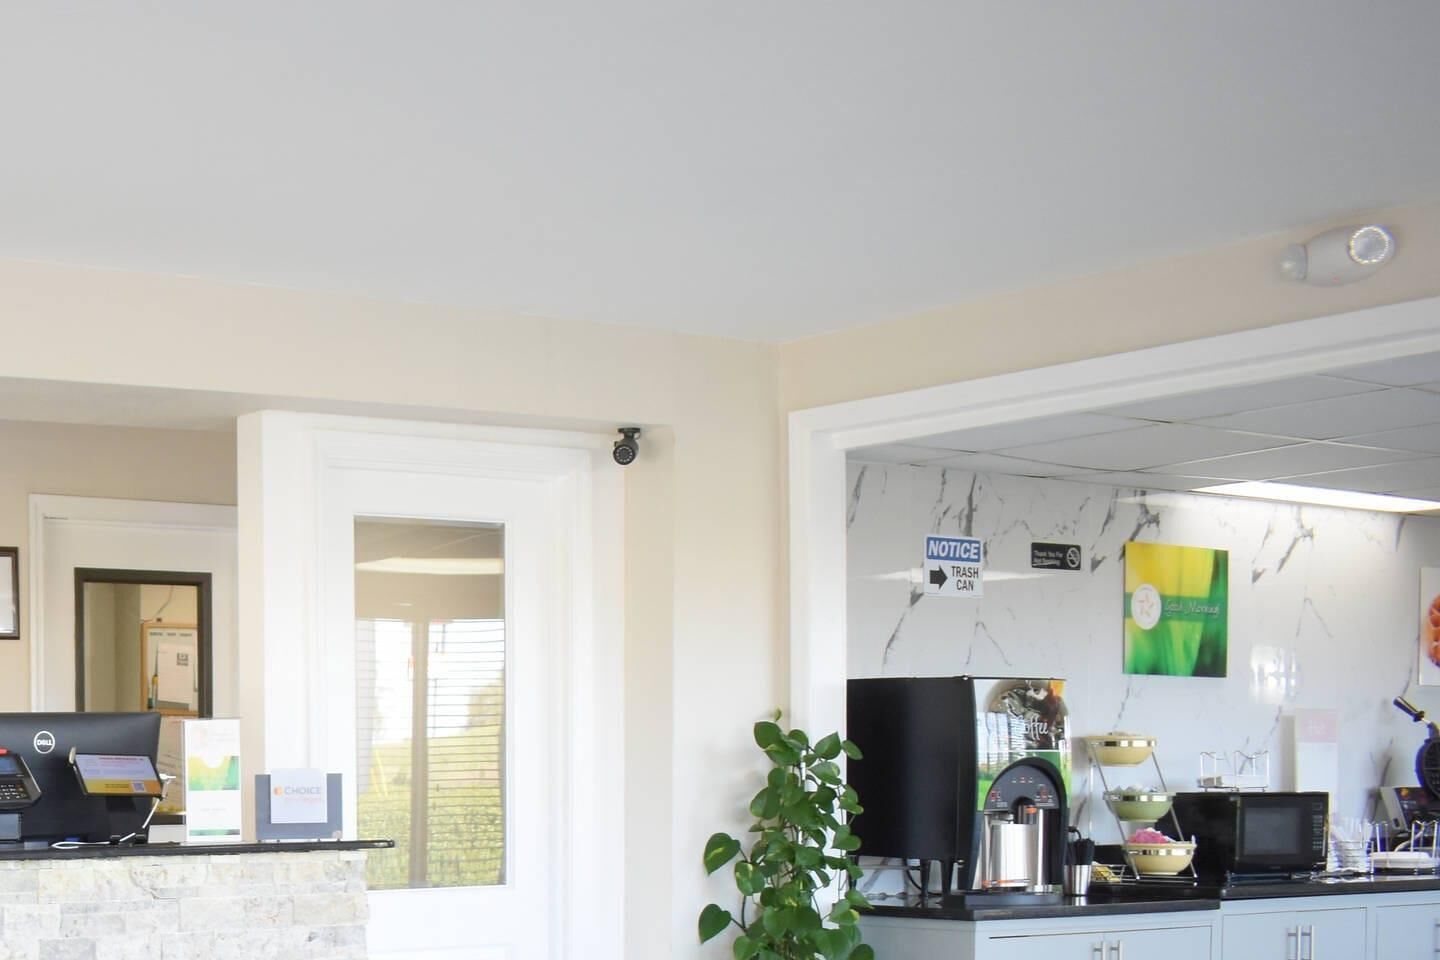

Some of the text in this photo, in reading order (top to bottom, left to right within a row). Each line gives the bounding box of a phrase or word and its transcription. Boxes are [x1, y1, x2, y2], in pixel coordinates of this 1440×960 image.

[928, 540, 980, 559] NOTICE
[951, 565, 979, 579] TRASH
[956, 578, 974, 591] CAN
[285, 786, 321, 795] CHOICE
